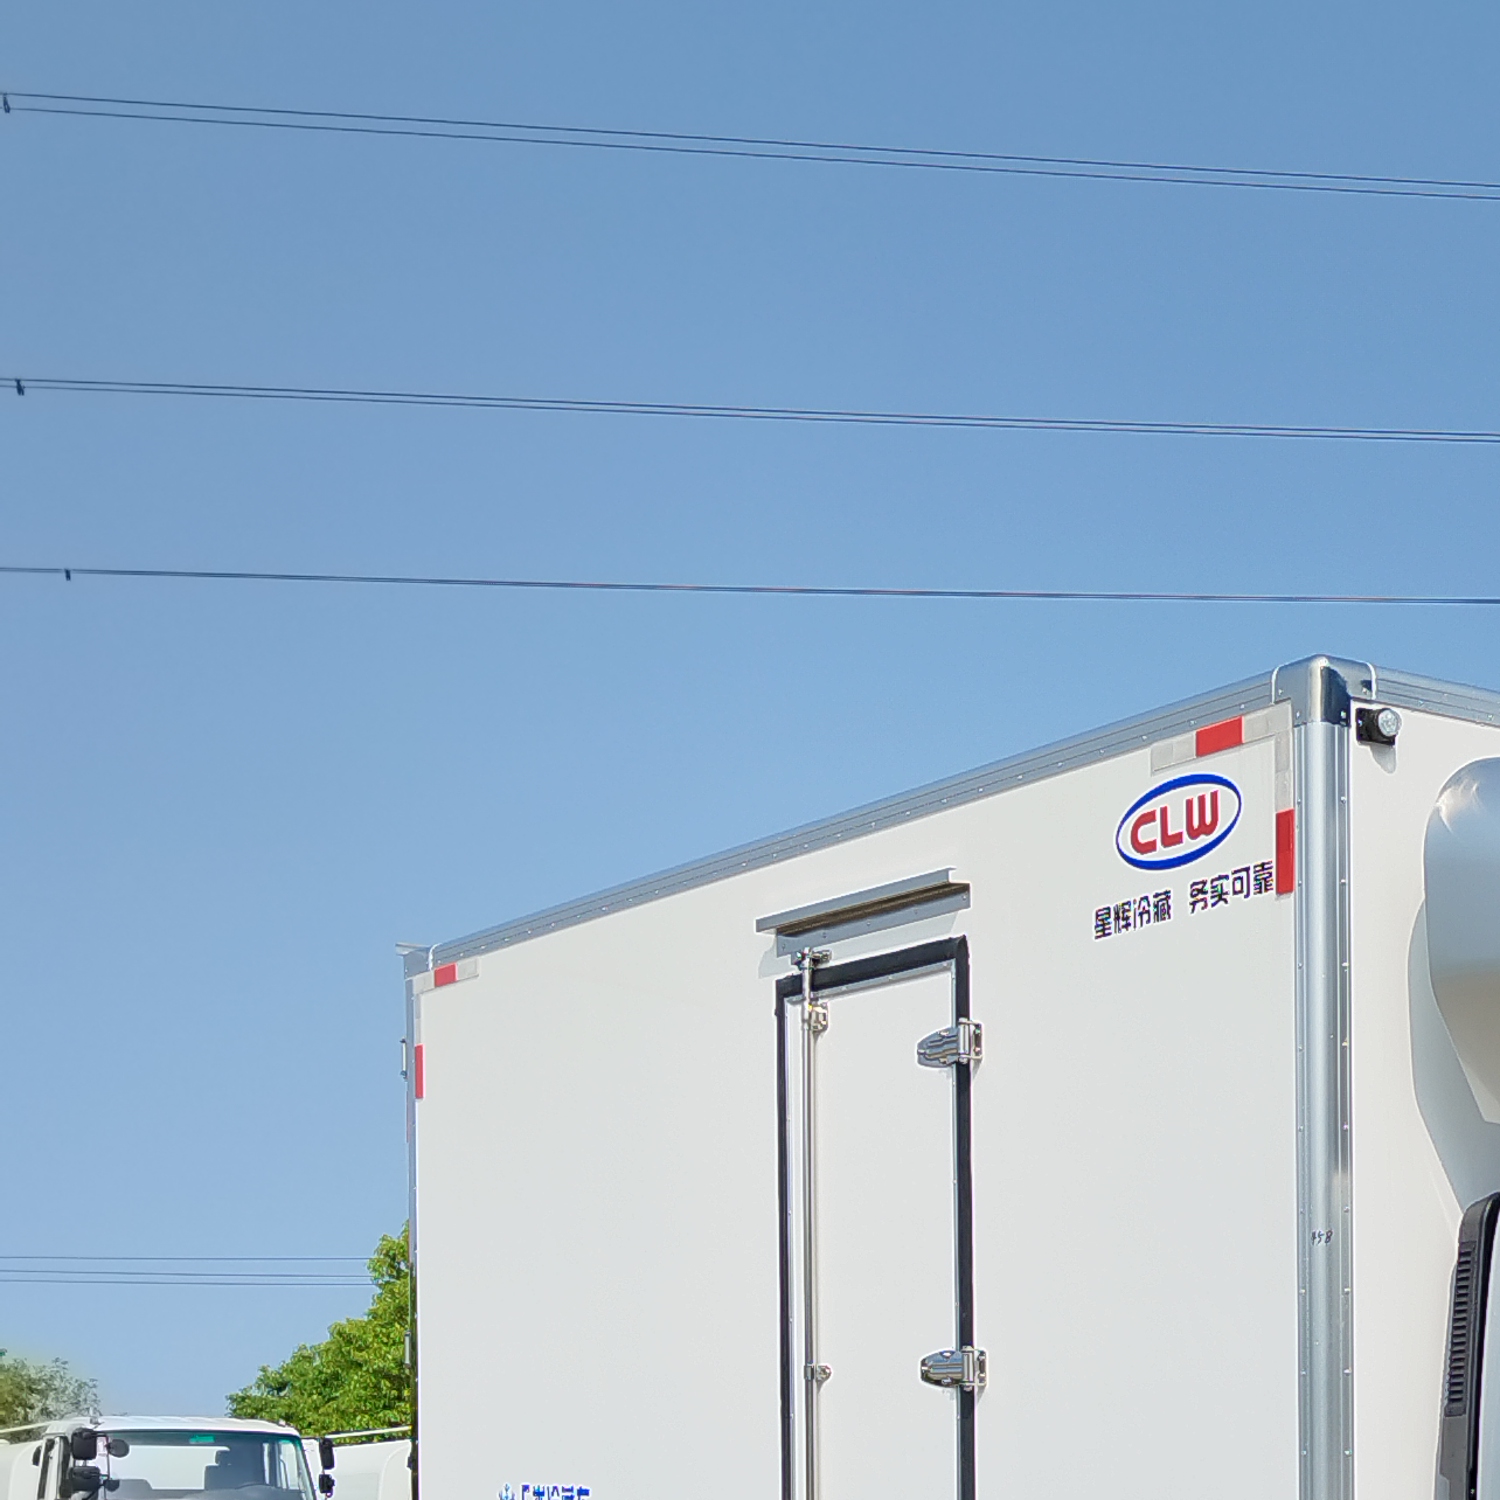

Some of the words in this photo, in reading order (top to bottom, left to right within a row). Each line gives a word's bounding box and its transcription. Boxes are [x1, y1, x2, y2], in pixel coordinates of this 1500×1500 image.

[1130, 790, 1219, 855] CLW
[1094, 889, 1172, 940] 星辉冷藏
[1189, 860, 1274, 914] 务实可靠
